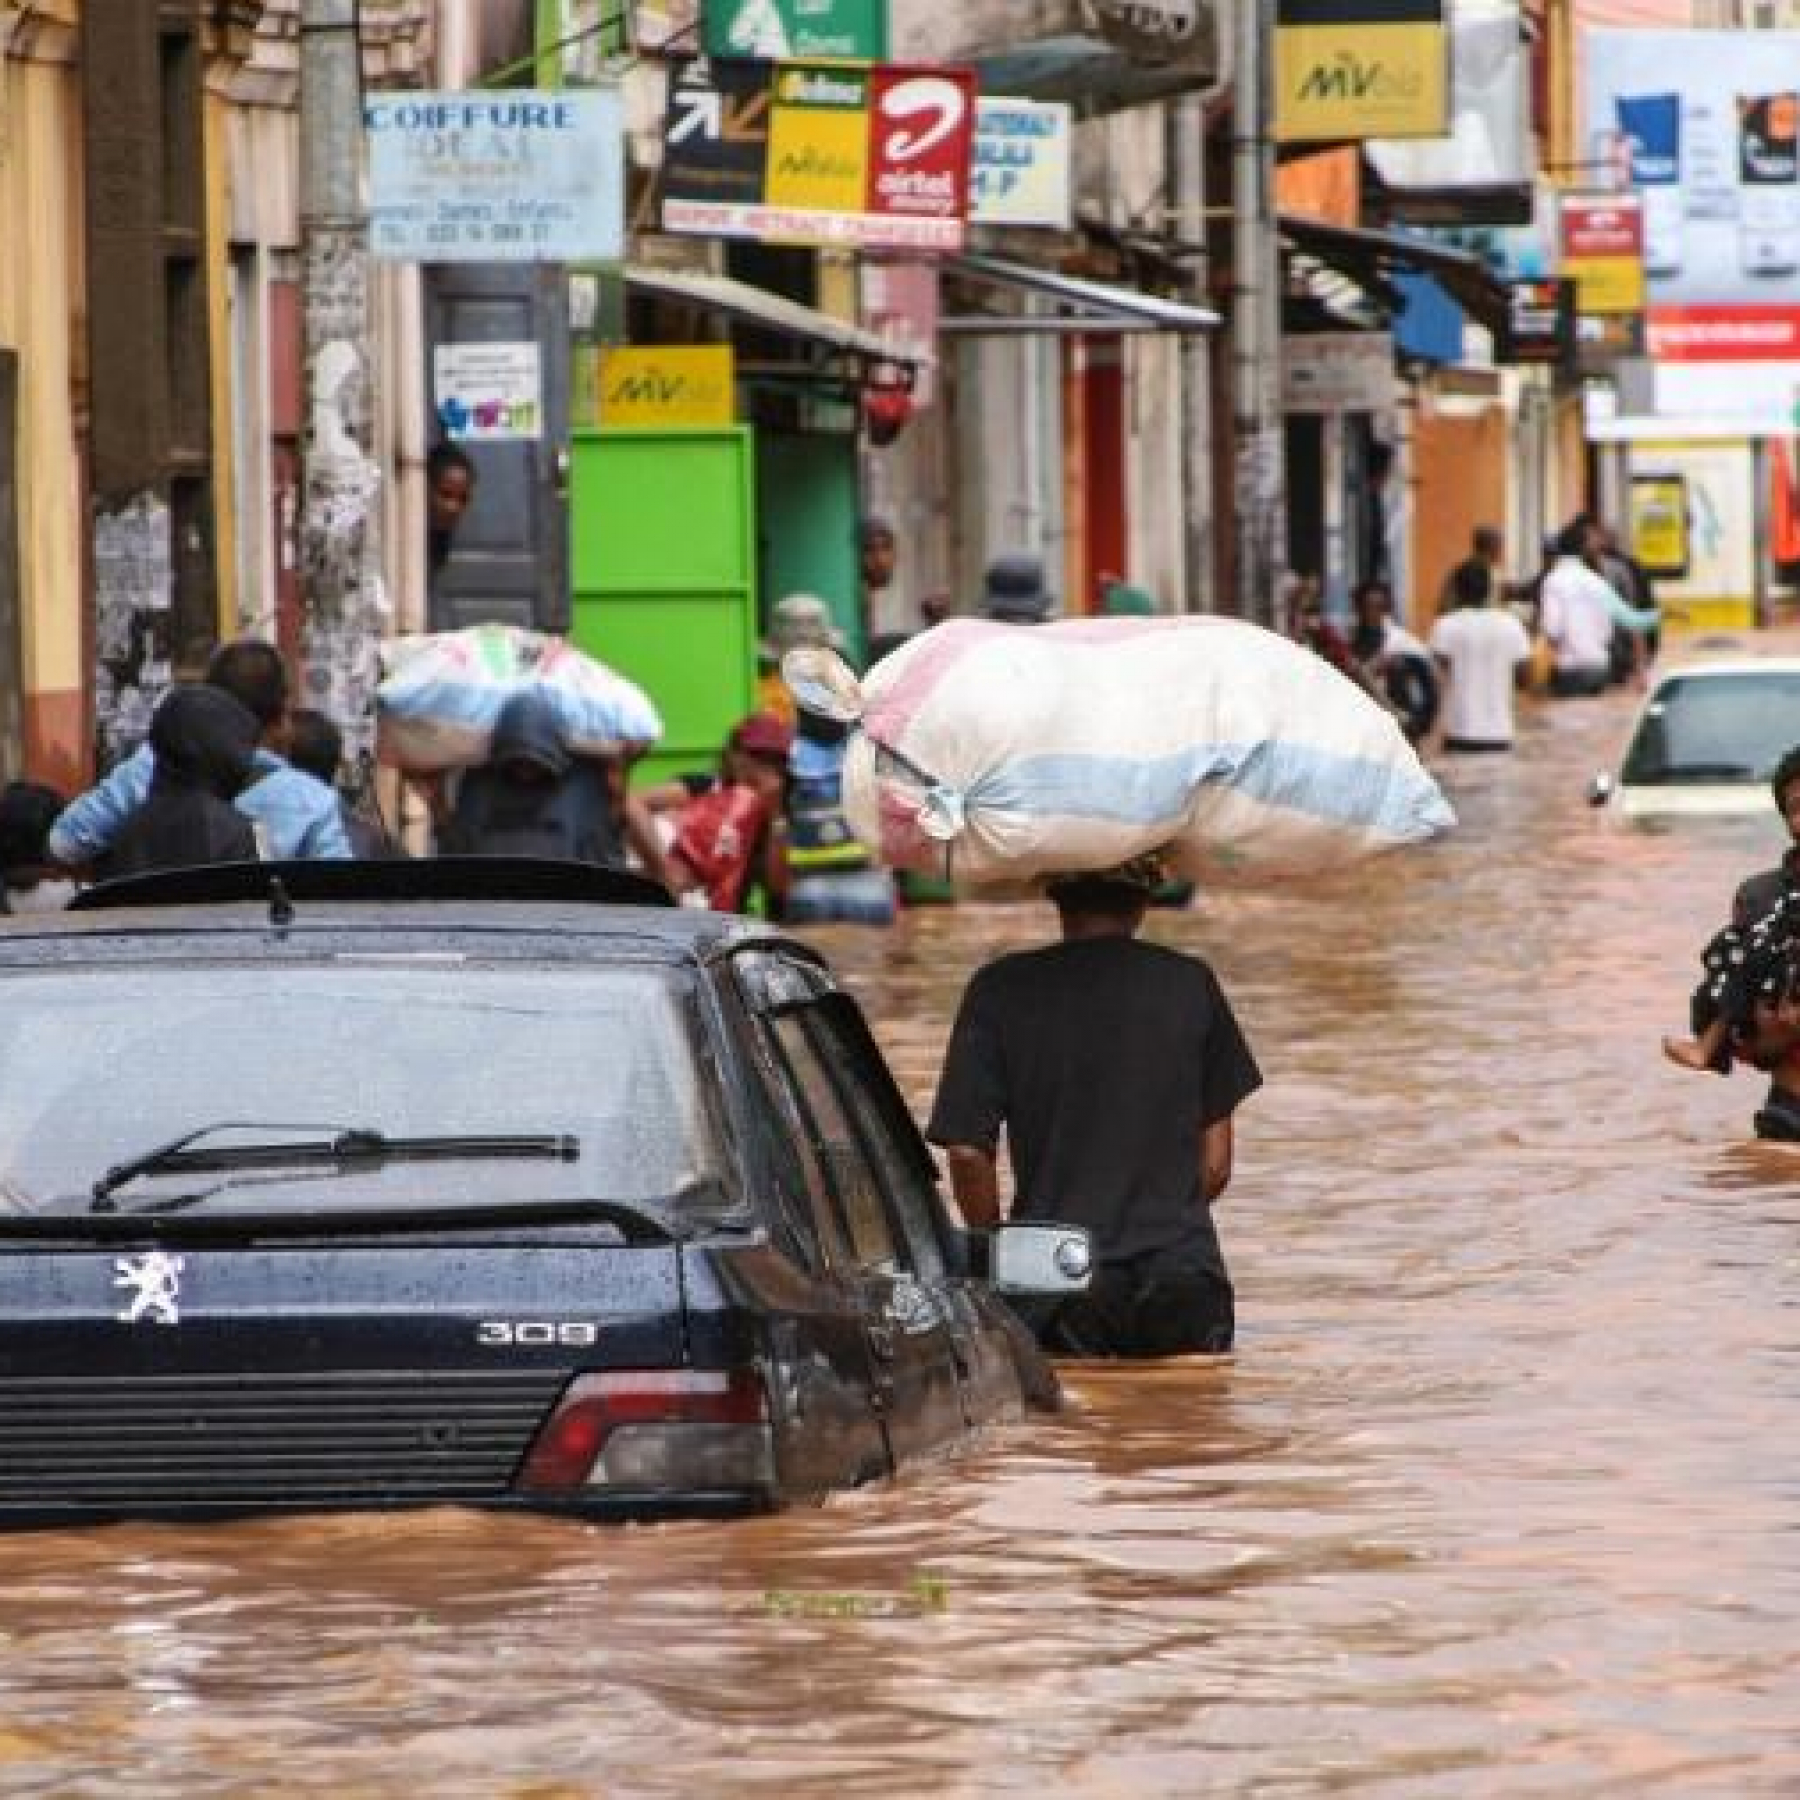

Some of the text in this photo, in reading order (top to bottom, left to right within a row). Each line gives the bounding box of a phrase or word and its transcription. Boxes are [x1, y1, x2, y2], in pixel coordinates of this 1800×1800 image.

[363, 102, 575, 131] COIFFURE
[876, 167, 955, 194] airtel
[477, 1322, 597, 1345] 309
